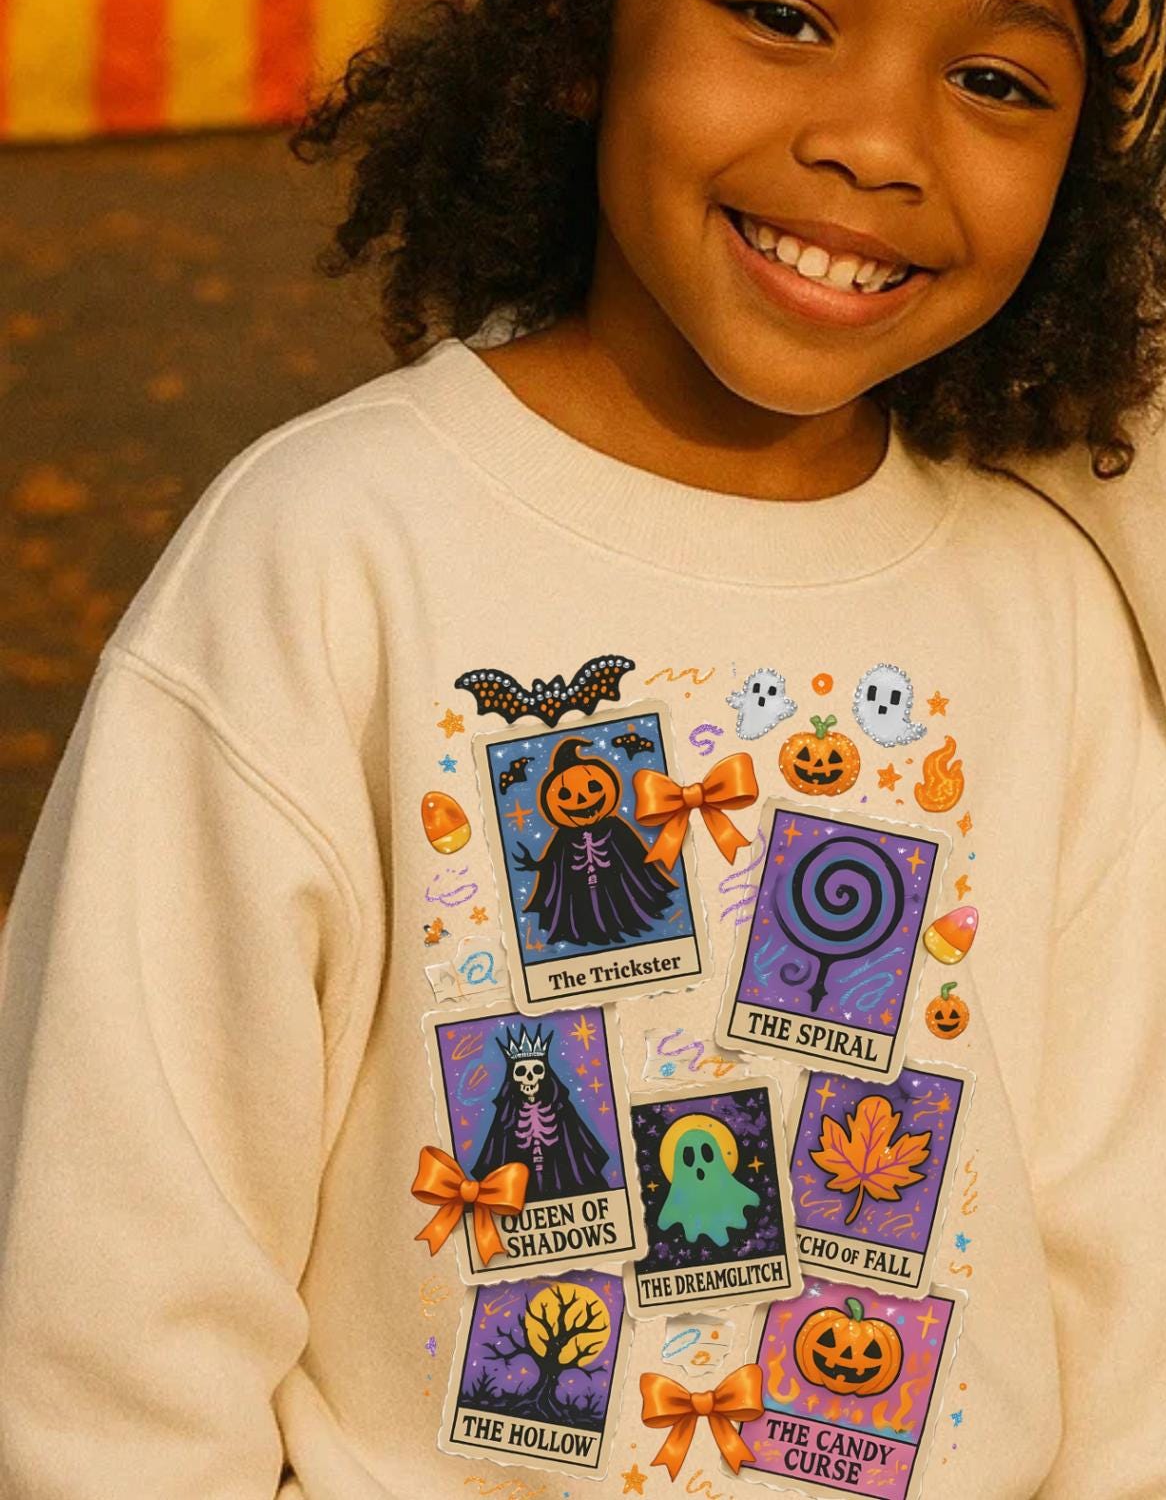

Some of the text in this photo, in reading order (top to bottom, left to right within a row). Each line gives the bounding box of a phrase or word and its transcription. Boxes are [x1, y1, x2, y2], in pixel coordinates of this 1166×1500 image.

[549, 956, 681, 990] The Trickster
[748, 1012, 878, 1062] THE SPIRAL
[501, 1198, 609, 1233] QUEEN OF
[506, 1222, 617, 1258] SHADOWS
[796, 1233, 838, 1260] CHO
[864, 1248, 912, 1278] FALL
[641, 1261, 784, 1299] THE DREAMGLITCH
[463, 1415, 598, 1457] THE HOLLOW
[766, 1419, 896, 1465] THE CANDY
[784, 1448, 862, 1485] CURSE
